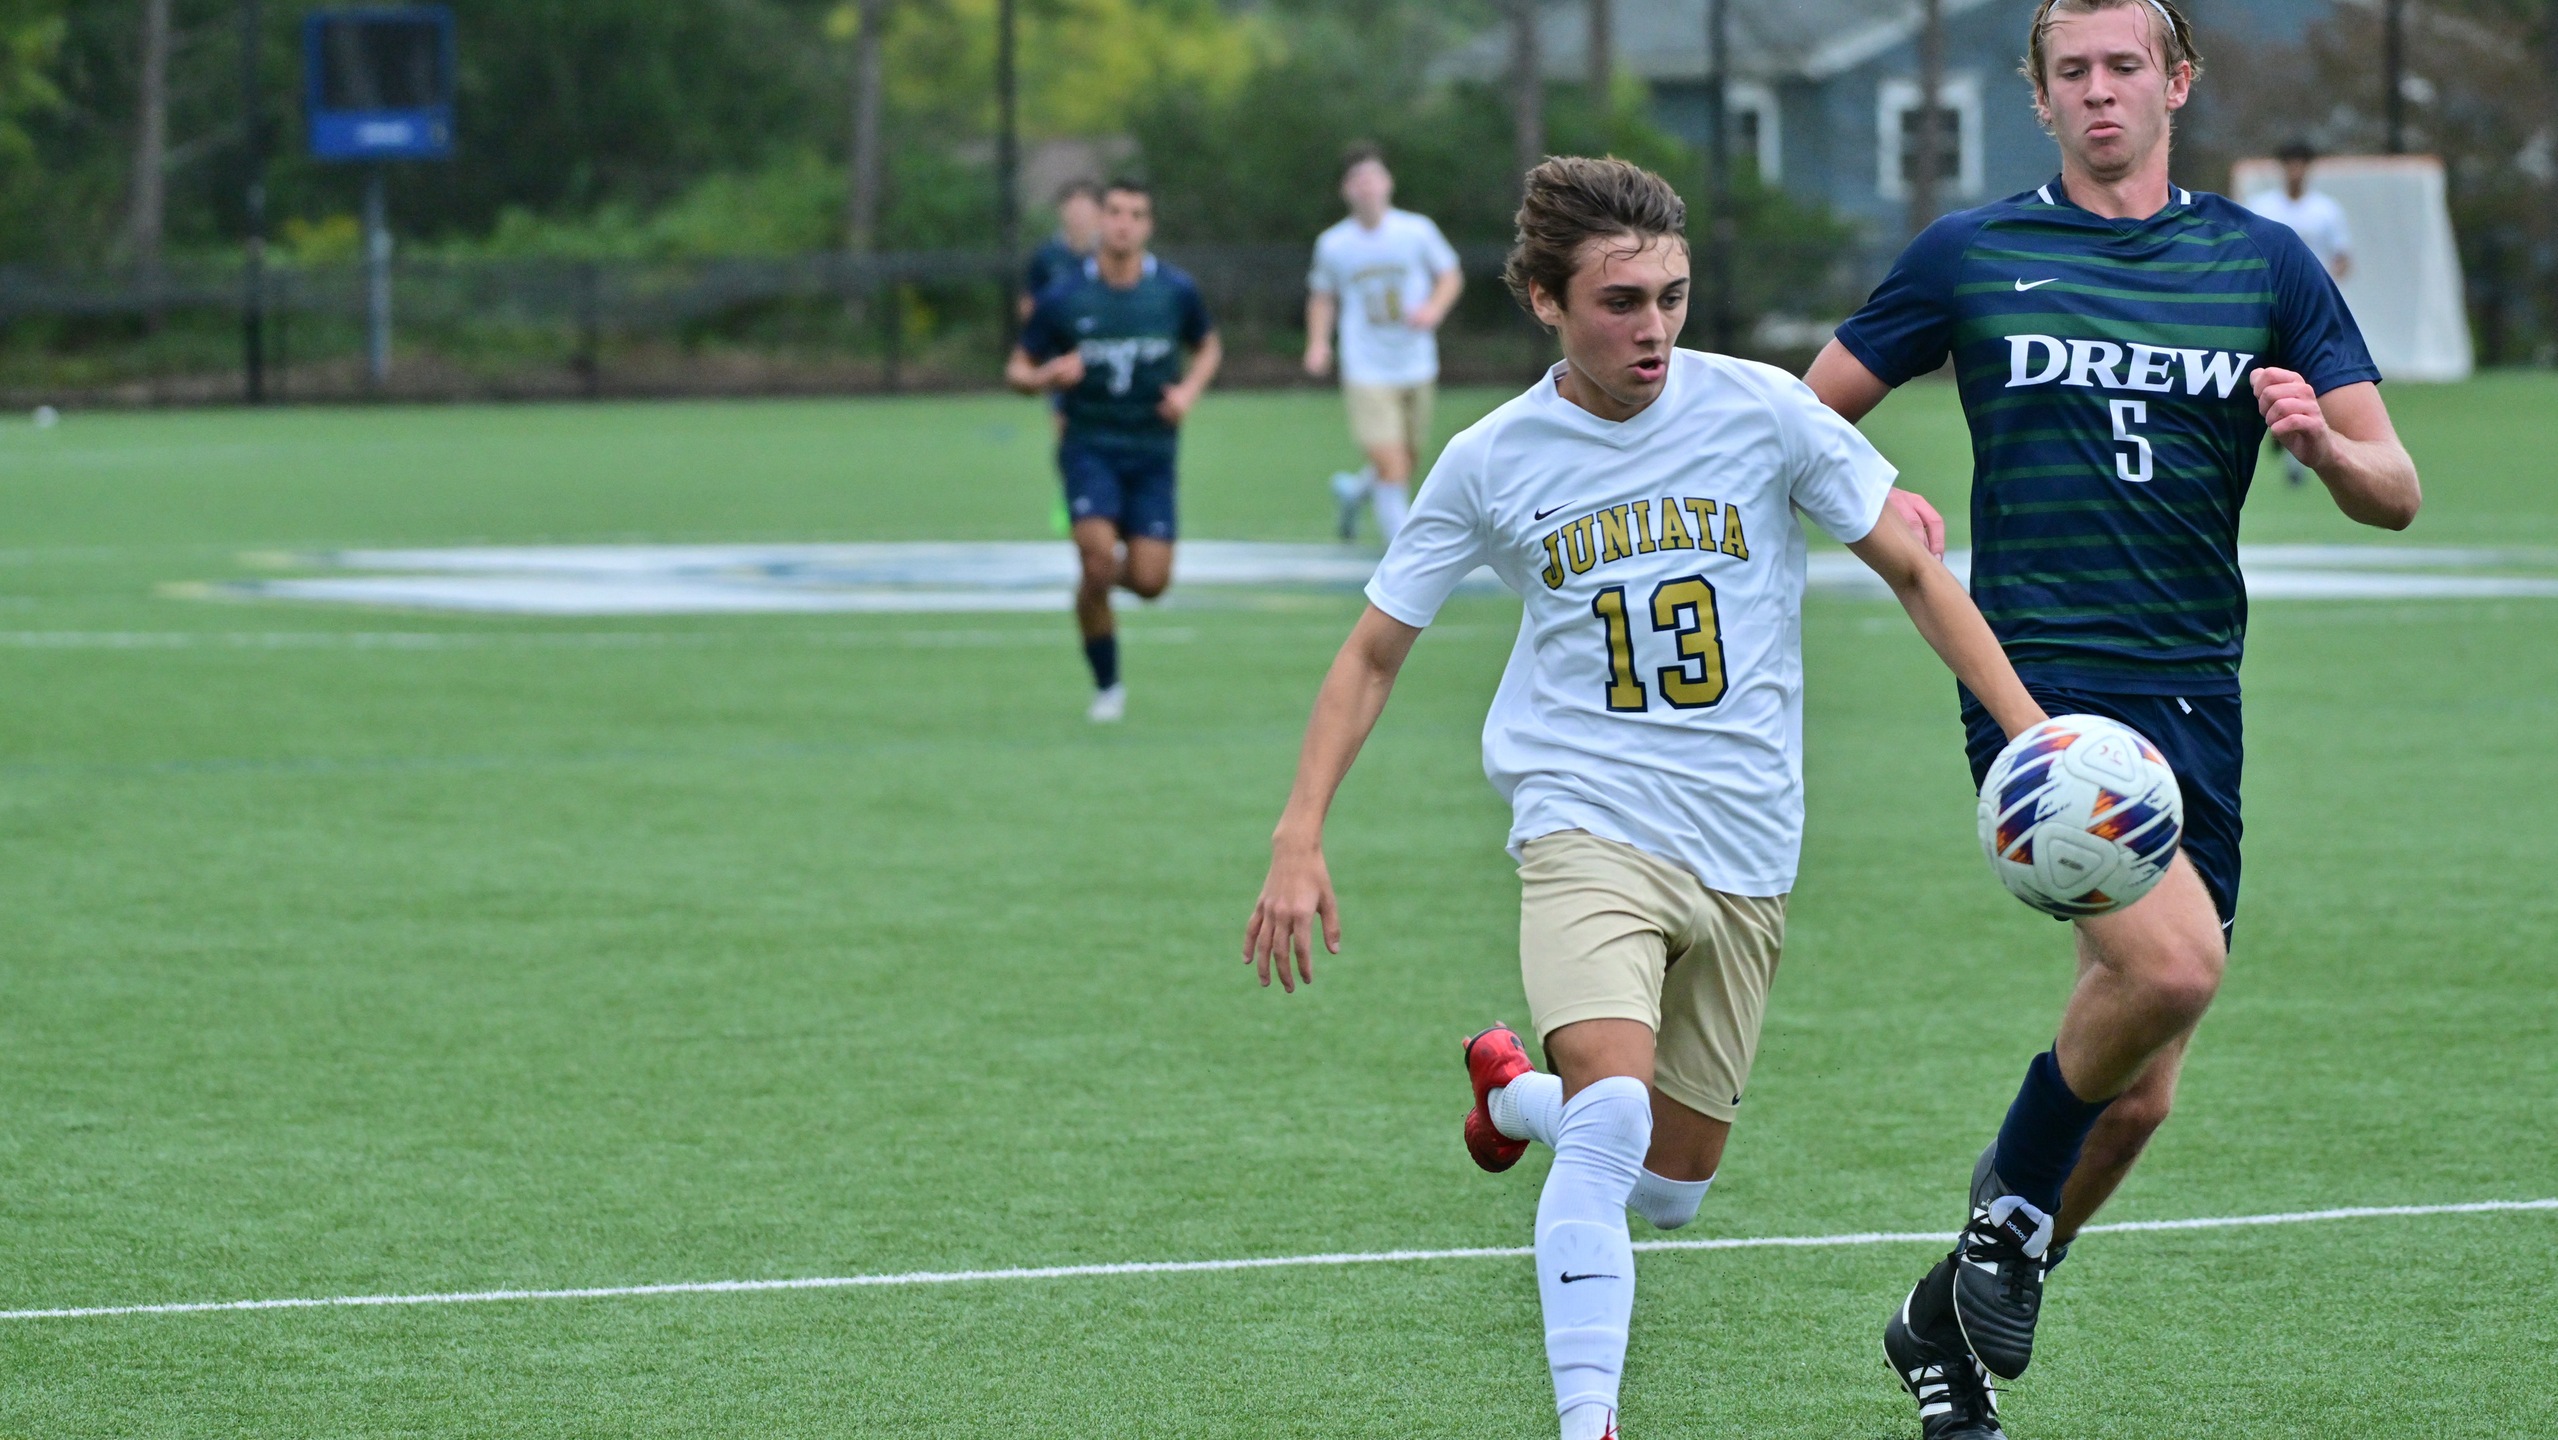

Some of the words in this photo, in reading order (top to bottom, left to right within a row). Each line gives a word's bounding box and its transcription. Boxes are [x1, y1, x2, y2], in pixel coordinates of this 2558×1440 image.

[2004, 334, 2254, 399] DREW
[2109, 399, 2153, 482] 5
[1541, 497, 1749, 590] JUNIATA
[1591, 573, 1729, 713] 13
